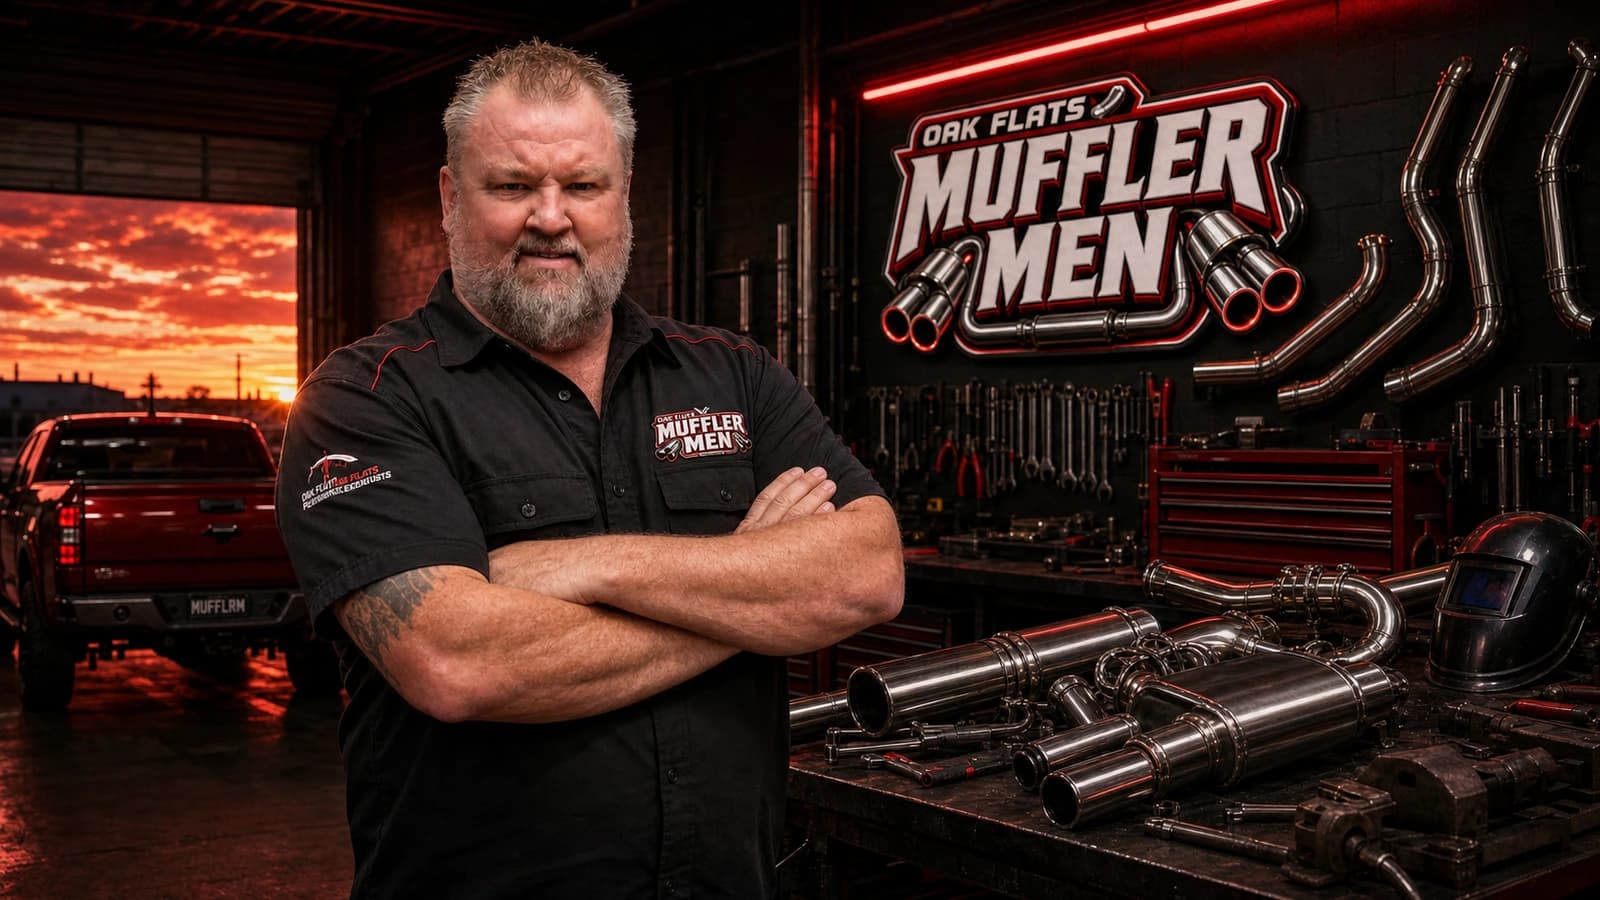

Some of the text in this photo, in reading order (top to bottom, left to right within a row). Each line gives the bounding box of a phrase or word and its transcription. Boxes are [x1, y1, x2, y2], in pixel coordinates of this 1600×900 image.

[923, 96, 1087, 147] OAK FLATS
[895, 98, 1269, 264] MUFFLER
[977, 206, 1177, 312] MEN
[656, 414, 745, 445] MUFFLER
[684, 431, 733, 454] MEN
[191, 599, 246, 615] MUFFLRM
